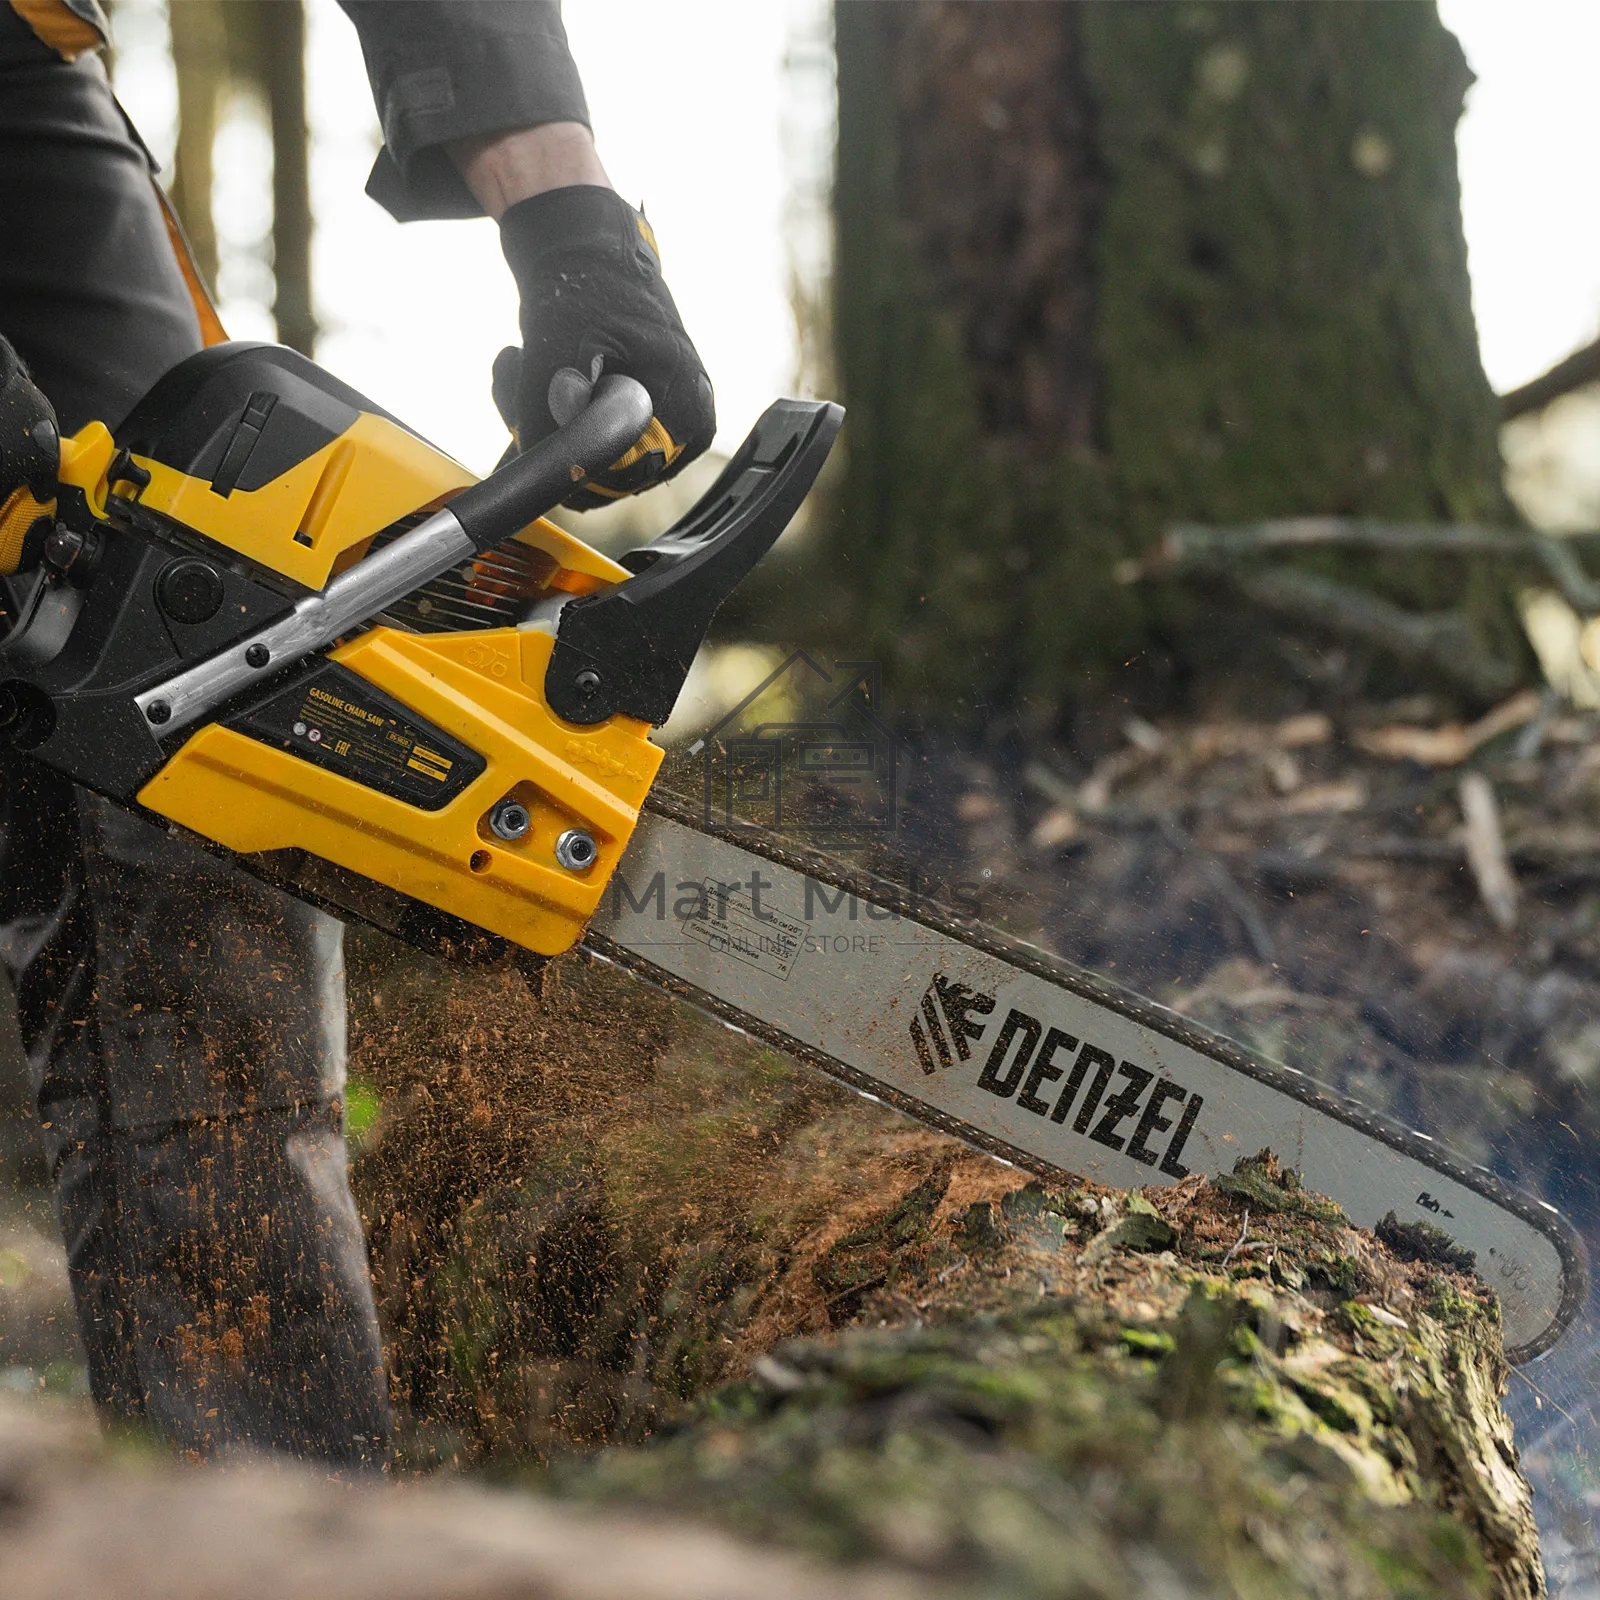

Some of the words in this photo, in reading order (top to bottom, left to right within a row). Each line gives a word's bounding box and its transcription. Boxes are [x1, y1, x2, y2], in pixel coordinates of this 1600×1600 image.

[309, 687, 345, 710] GASOLINE
[344, 703, 368, 720] CHAIN
[366, 713, 385, 727] SAW
[777, 963, 787, 972] 76
[976, 1008, 1204, 1180] DENZEL
